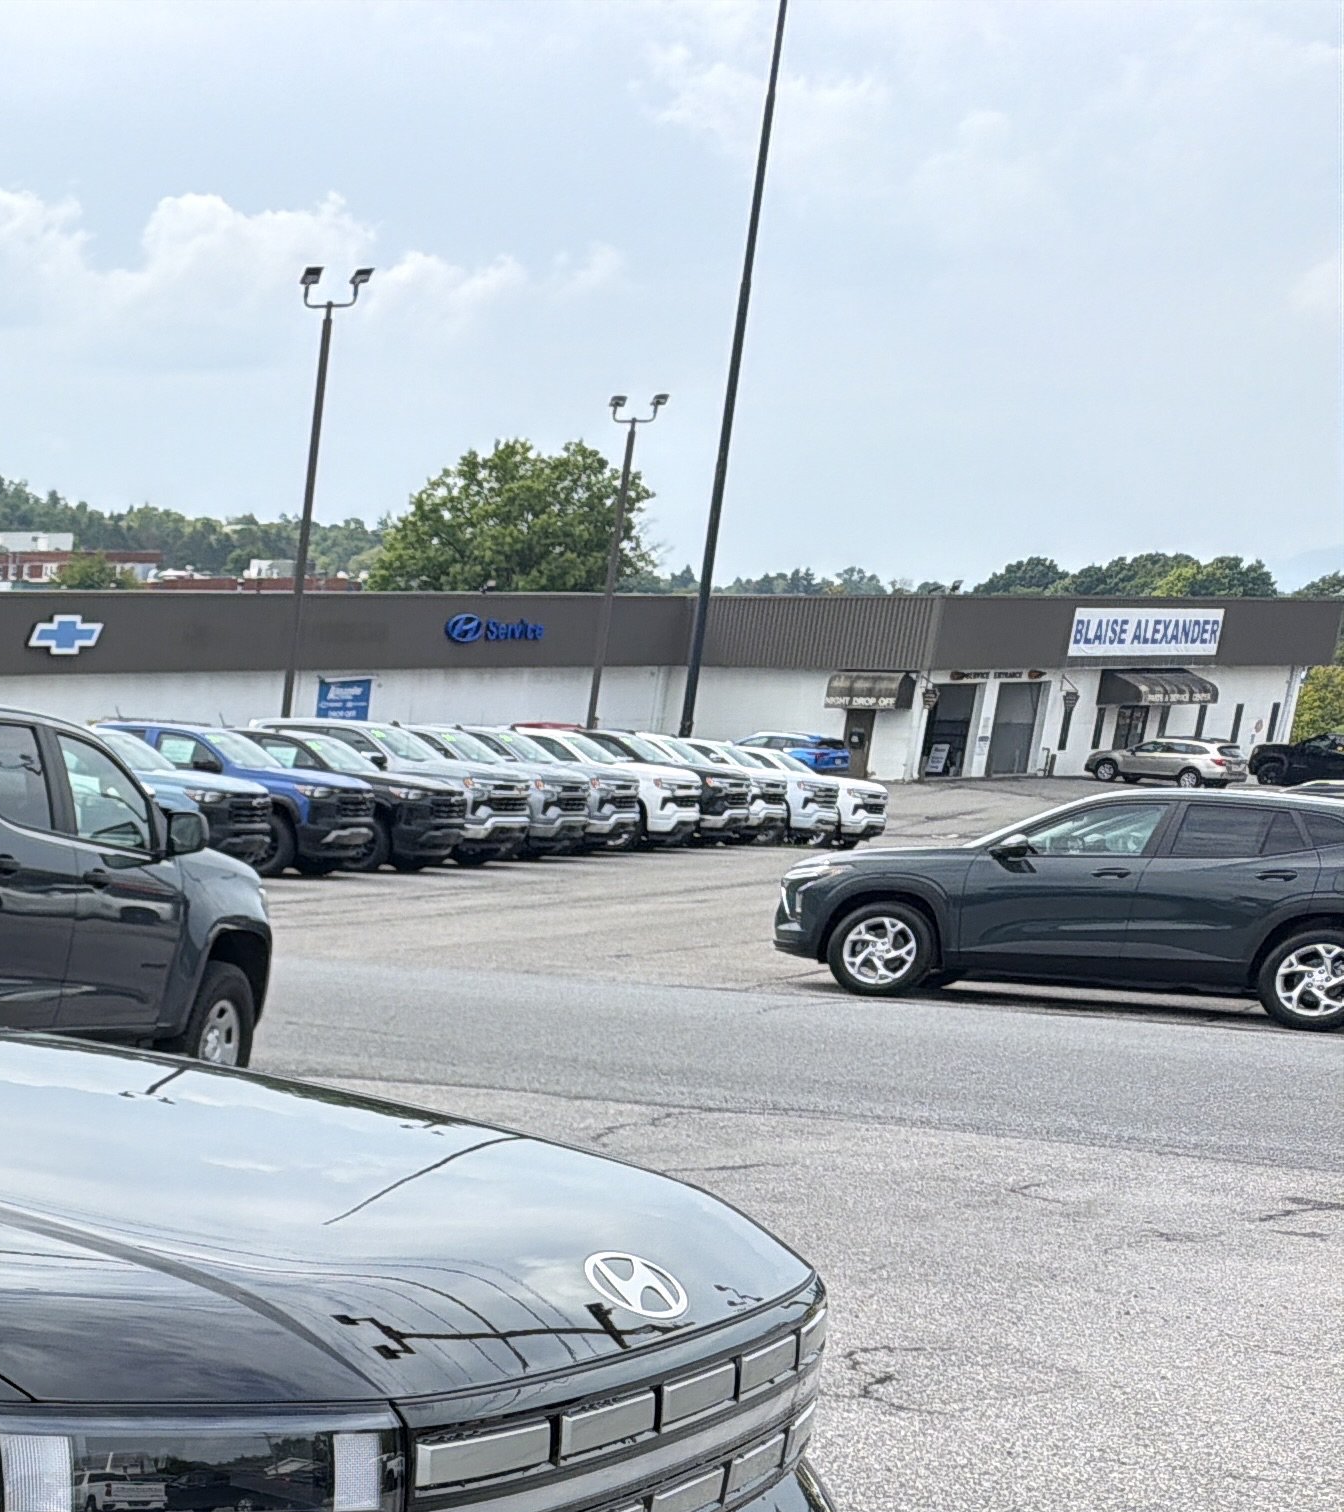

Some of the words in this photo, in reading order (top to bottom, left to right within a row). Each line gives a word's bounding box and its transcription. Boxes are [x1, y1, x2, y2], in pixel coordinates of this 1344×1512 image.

[485, 616, 545, 640] Service
[1072, 618, 1130, 645] BLAISE
[1130, 618, 1220, 645] ALEXANDER
[852, 696, 877, 706] DROP
[878, 696, 897, 707] OFF
